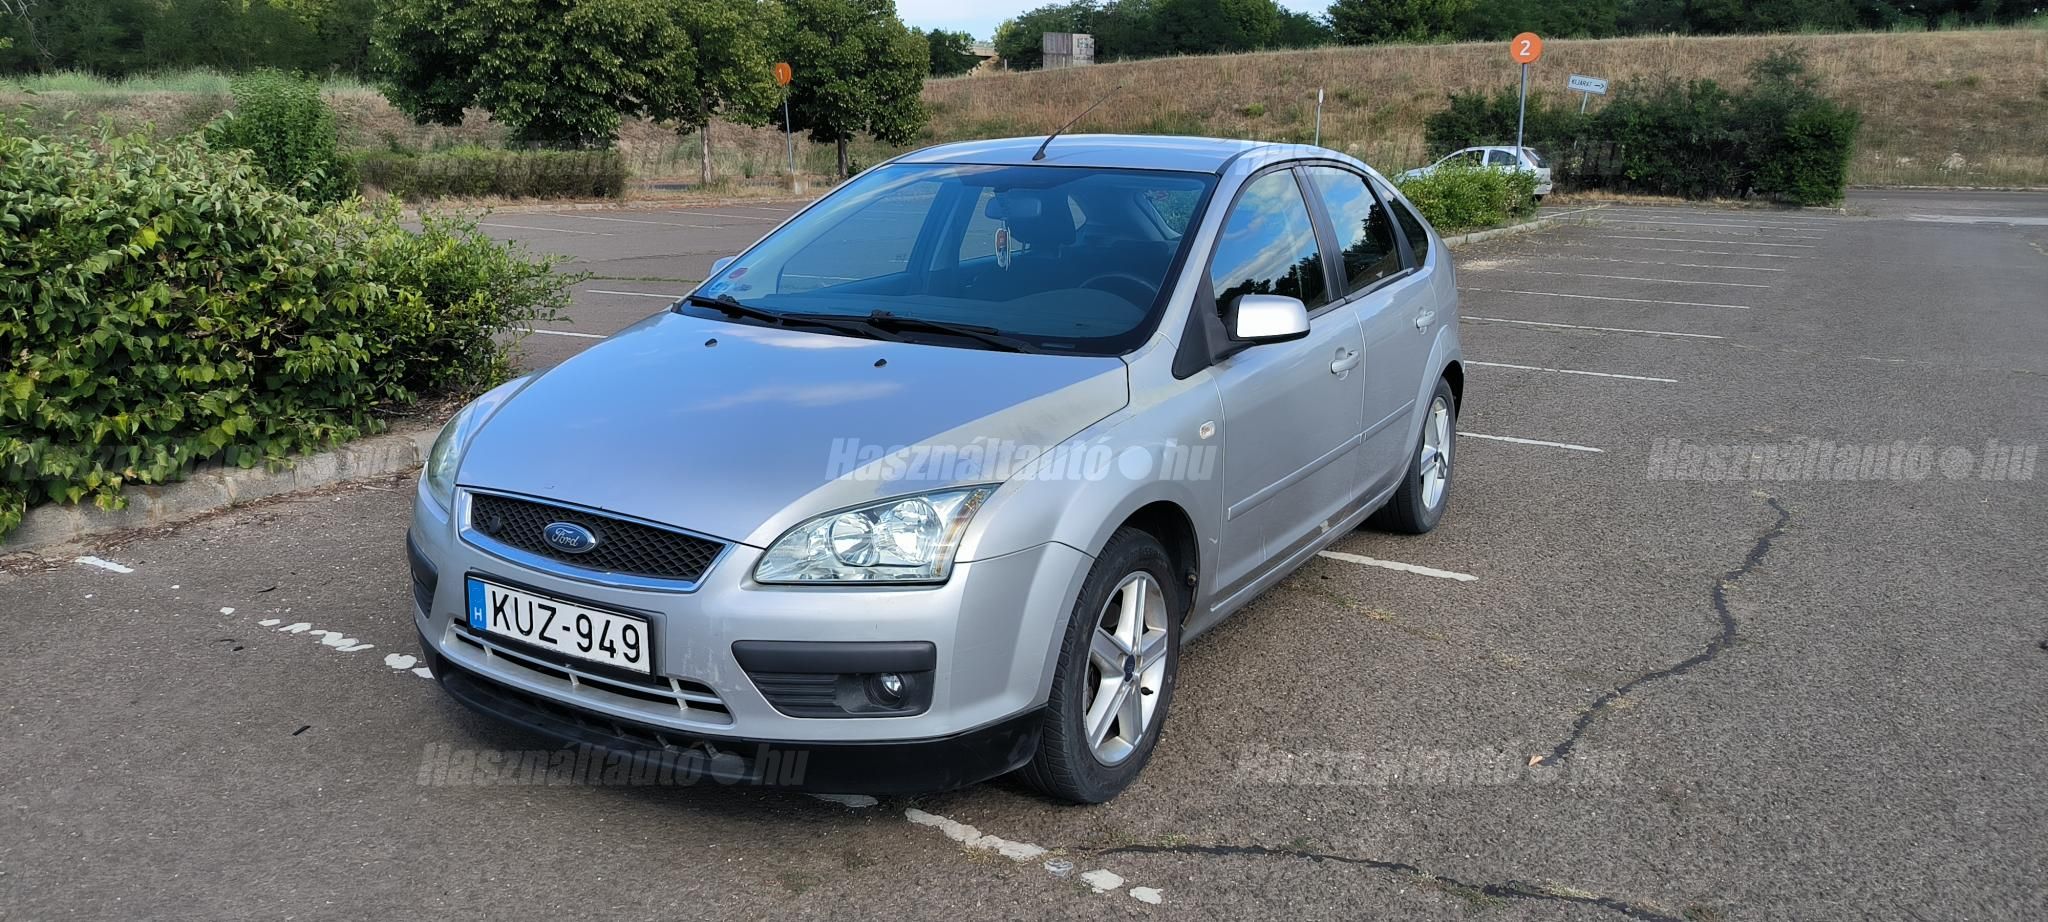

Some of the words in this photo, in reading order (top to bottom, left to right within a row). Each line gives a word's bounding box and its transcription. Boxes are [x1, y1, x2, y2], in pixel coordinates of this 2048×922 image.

[1520, 40, 1530, 56] 2
[552, 527, 579, 547] Ford
[474, 606, 483, 622] H
[492, 591, 640, 663] KUZ-949
